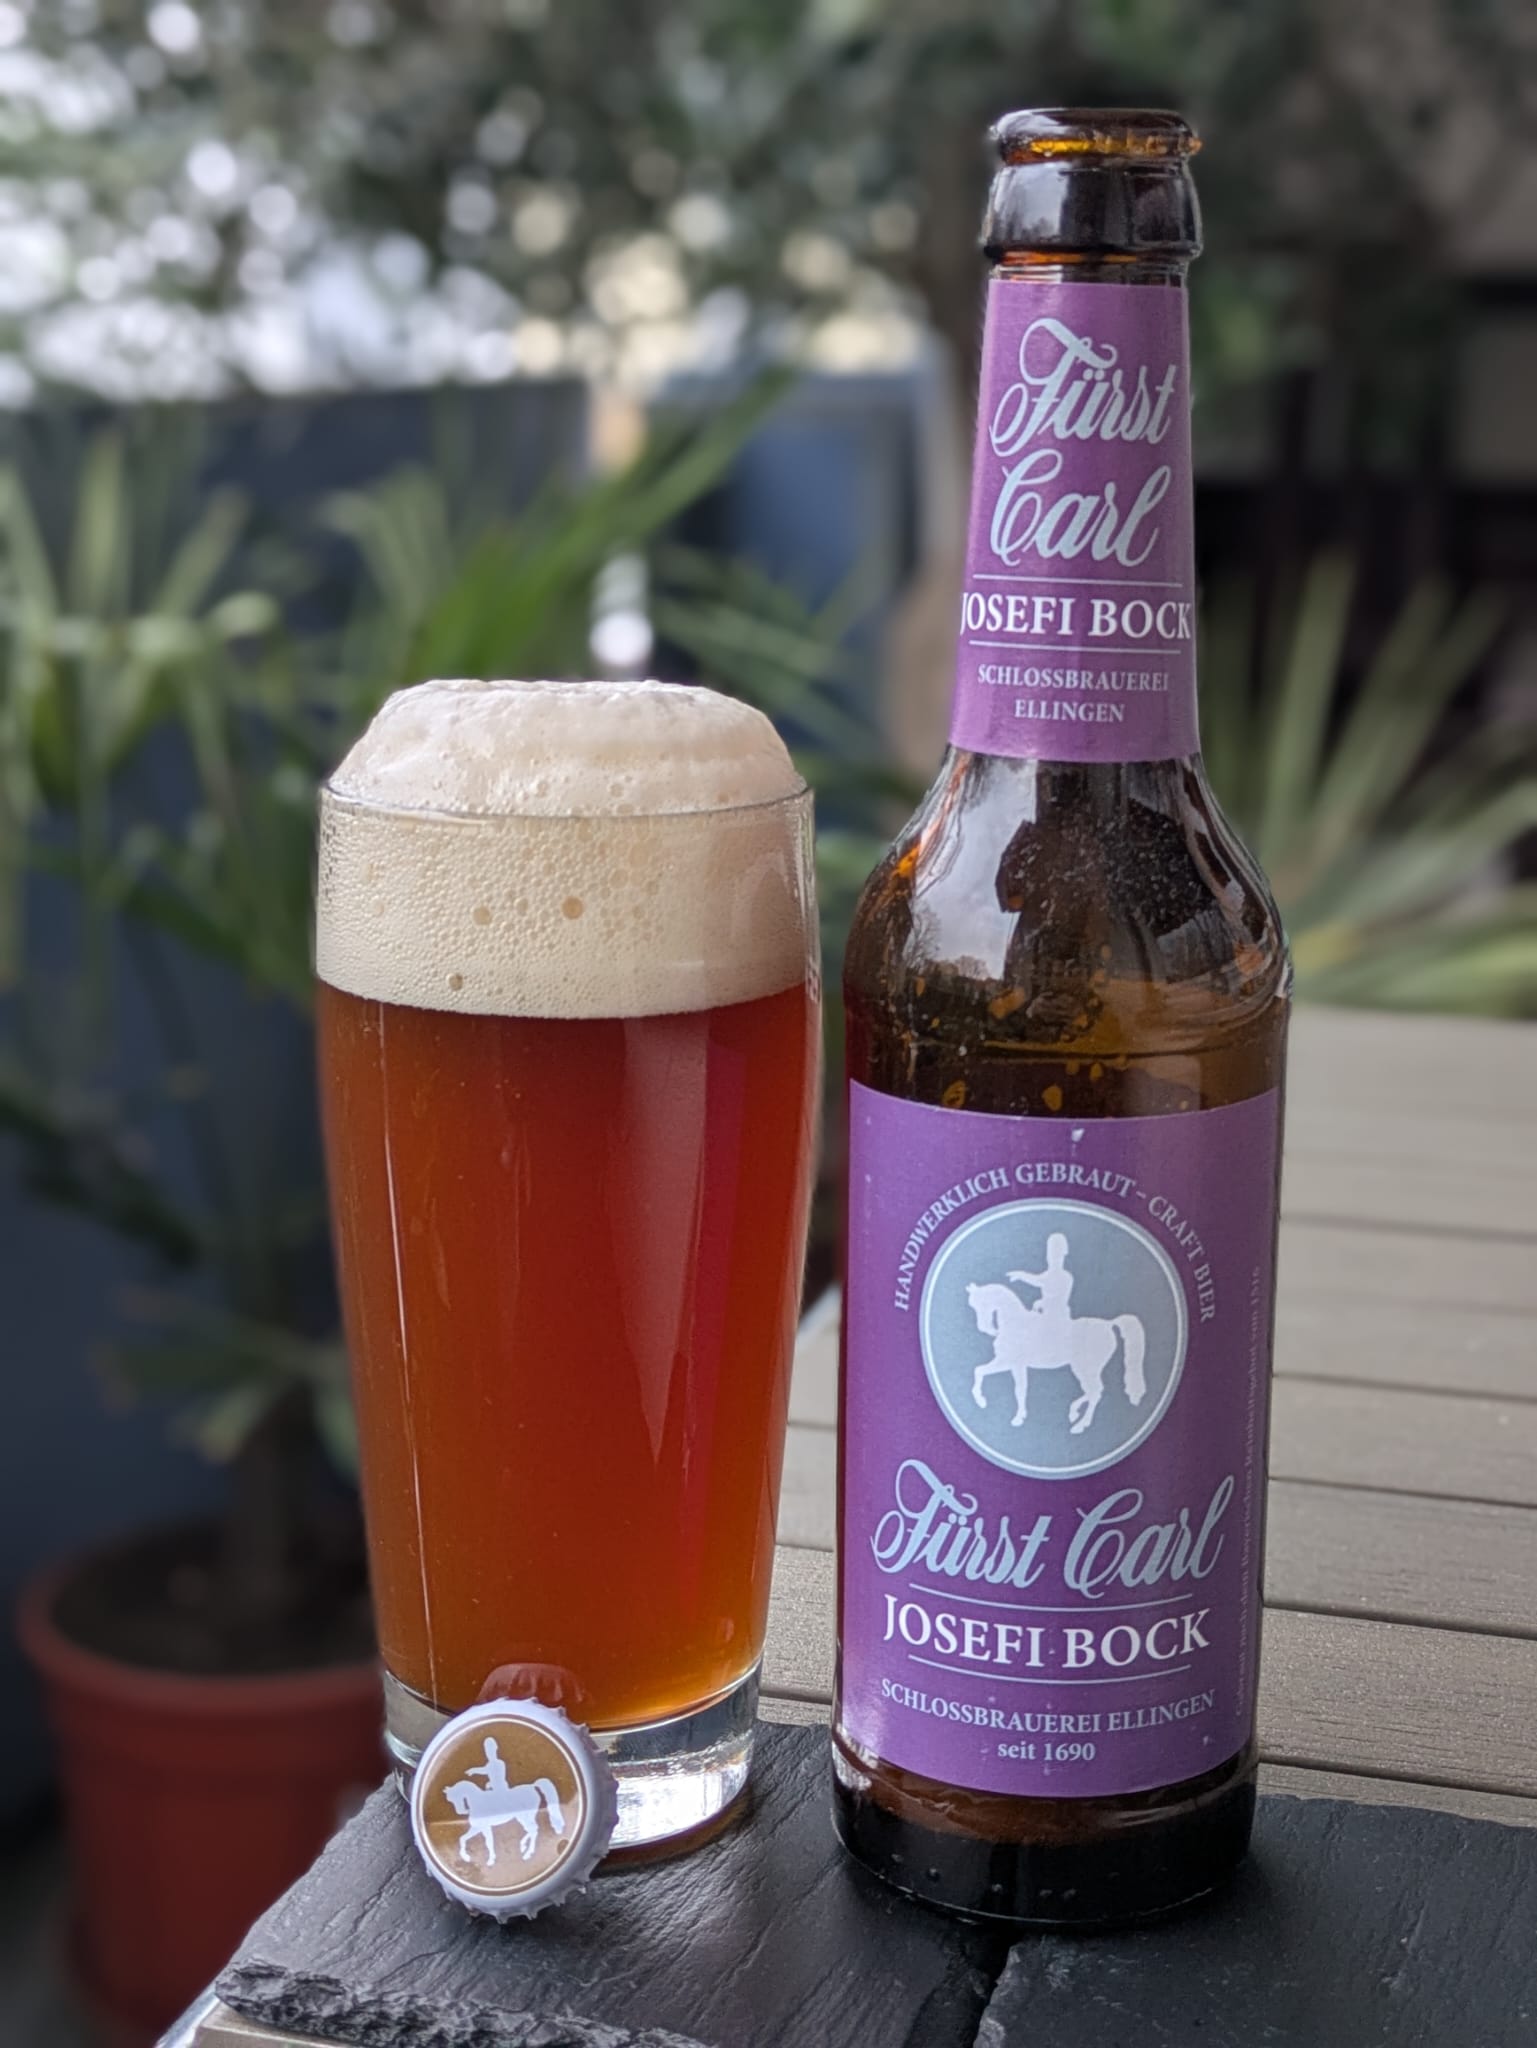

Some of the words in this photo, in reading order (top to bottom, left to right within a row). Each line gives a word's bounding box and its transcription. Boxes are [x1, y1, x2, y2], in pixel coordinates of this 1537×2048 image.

[989, 318, 1176, 456] Fürst
[990, 449, 1172, 567] Carl
[960, 592, 1076, 636] JOSEFI
[1088, 598, 1192, 640] BOCK
[978, 664, 1169, 692] SCHLOSSBRAUEREI
[1014, 699, 1125, 723] ELLINGEN
[895, 1168, 1010, 1311] HANDWERKLICH
[1015, 1163, 1135, 1199] GEBRAUT
[1148, 1196, 1206, 1262] CRAFT
[1193, 1263, 1216, 1323] BIER
[870, 1459, 1053, 1588] Fürst
[1064, 1474, 1235, 1599] Carl
[883, 1594, 1046, 1667] JOSEFI
[1062, 1608, 1211, 1669] BOCK
[881, 1678, 1100, 1733] SCHLOSSBRAUEREI
[1106, 1689, 1216, 1732] ELLINGEN
[997, 1741, 1037, 1761] seit
[1043, 1742, 1096, 1762] 1690
